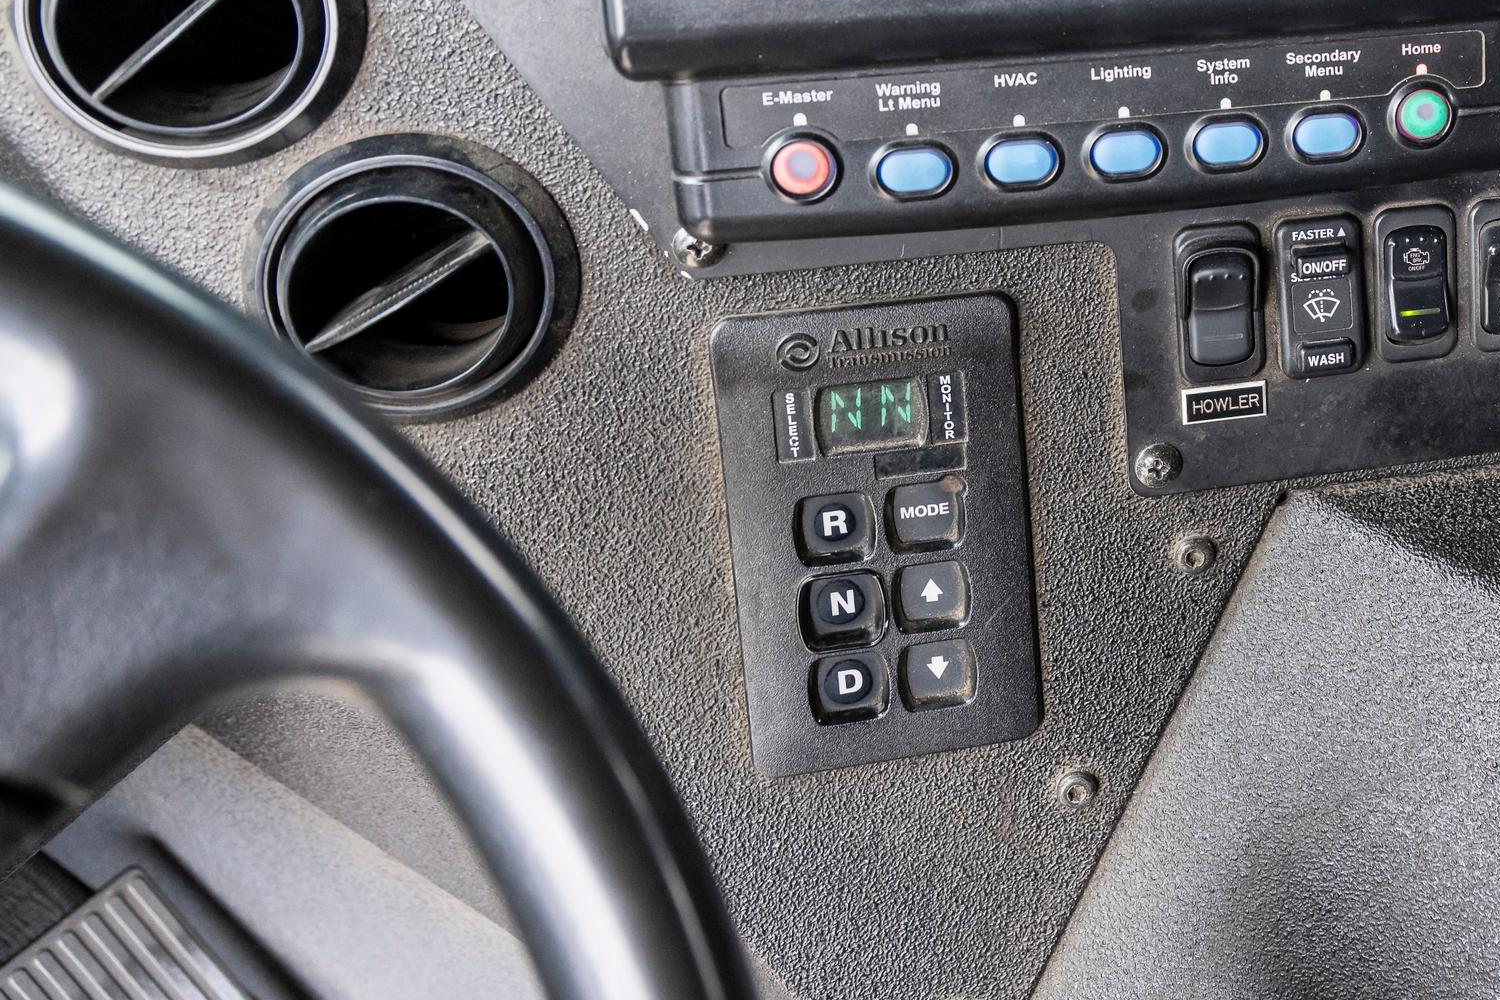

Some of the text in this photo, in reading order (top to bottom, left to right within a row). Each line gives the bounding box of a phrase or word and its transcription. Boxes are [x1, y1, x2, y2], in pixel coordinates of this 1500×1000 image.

[1286, 48, 1361, 65] Secondary
[1402, 42, 1441, 56] Home
[1090, 64, 1152, 81] Lighting
[1197, 56, 1250, 74] System
[1305, 63, 1343, 78] Menu
[994, 72, 1038, 88] HVAC
[1210, 70, 1238, 86] Info
[762, 88, 833, 106] E-Master
[876, 80, 940, 97] Warning
[878, 96, 940, 112] Lt Menu
[1292, 229, 1334, 241] FASTER
[1302, 259, 1347, 274] ON/OFF
[828, 323, 950, 353] Allison
[827, 346, 951, 369] Transmission
[1308, 352, 1344, 367] WASH
[940, 375, 955, 439] MONITOR
[1192, 393, 1259, 415] HOWLER
[785, 392, 798, 458] SELECT
[900, 502, 950, 519] MODE
[822, 509, 848, 536] R
[830, 589, 856, 616] N
[837, 669, 864, 695] D
